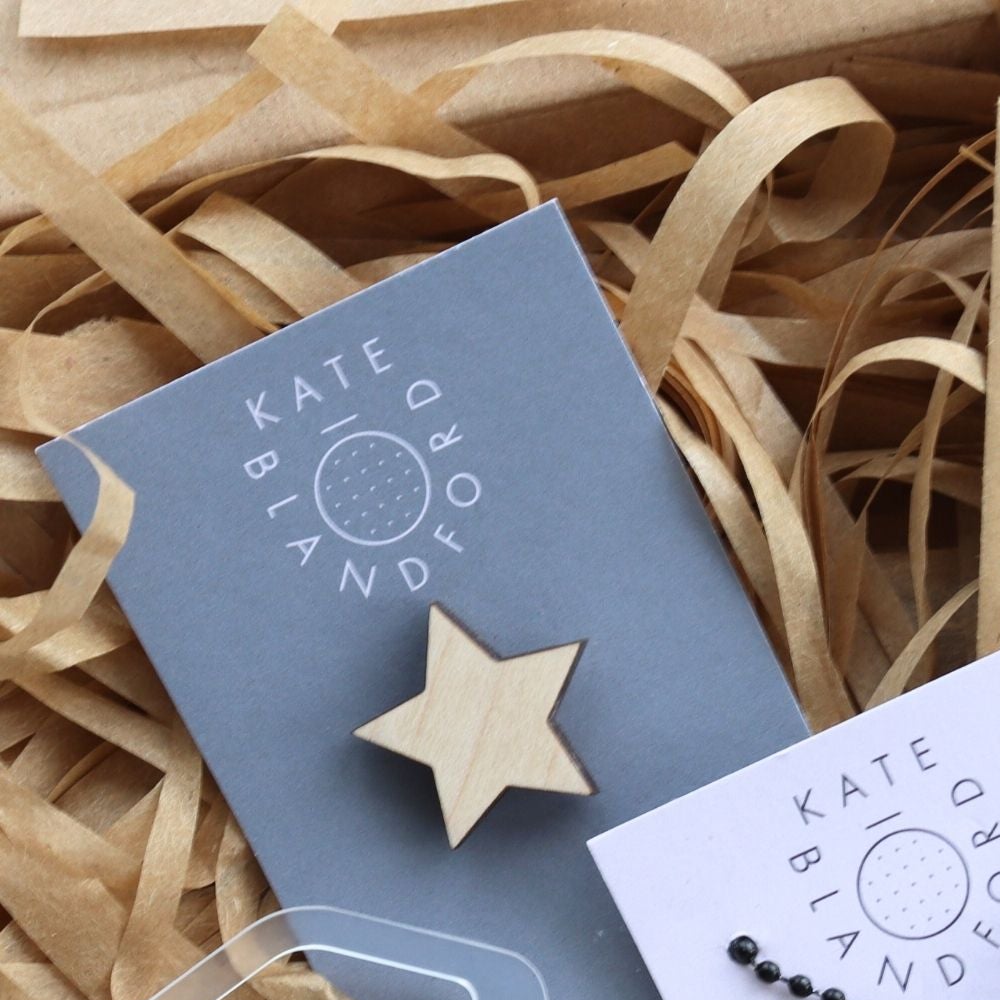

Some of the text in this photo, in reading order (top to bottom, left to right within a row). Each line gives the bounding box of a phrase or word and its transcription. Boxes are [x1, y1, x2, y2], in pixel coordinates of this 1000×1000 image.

[245, 336, 394, 430] KATE
[243, 379, 482, 599] BLANDFORD
[792, 736, 937, 826] KATE
